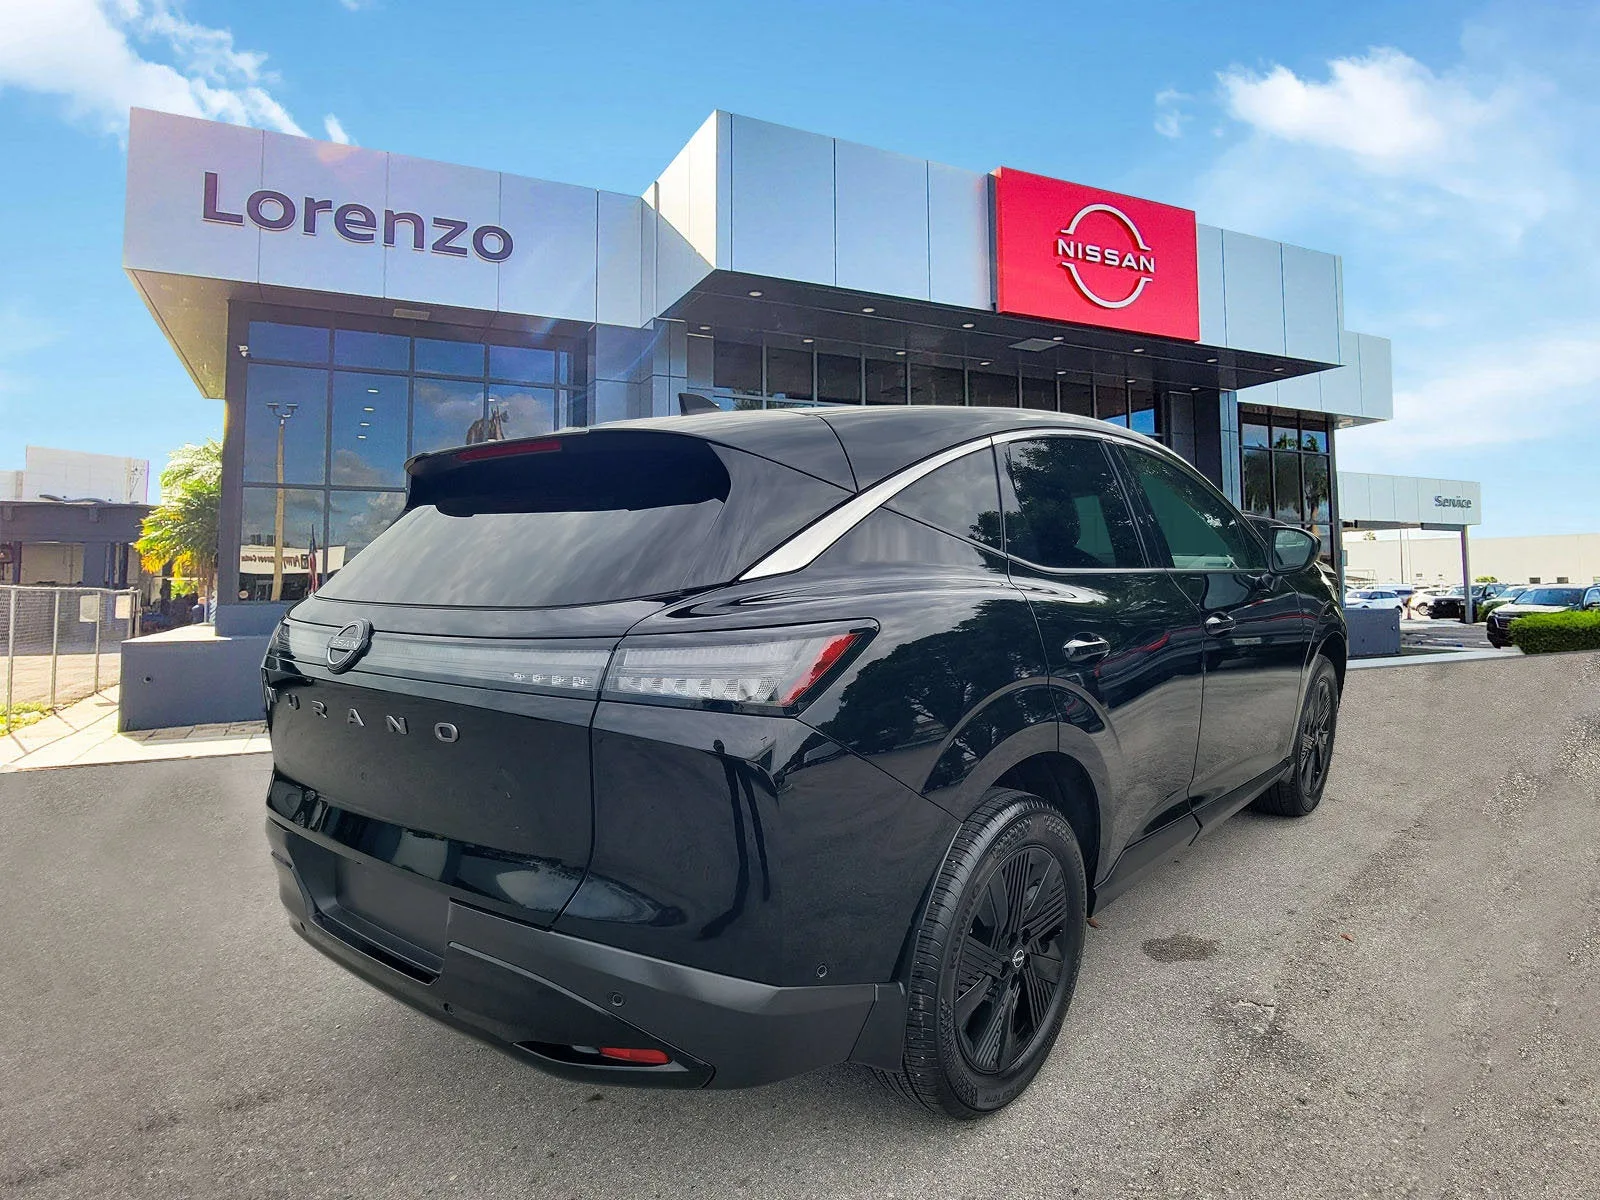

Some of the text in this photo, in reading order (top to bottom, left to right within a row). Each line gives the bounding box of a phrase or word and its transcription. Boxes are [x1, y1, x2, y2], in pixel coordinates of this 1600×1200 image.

[203, 171, 514, 262] Lorenzo
[1058, 238, 1155, 273] NISSAN
[1434, 495, 1472, 509] Service
